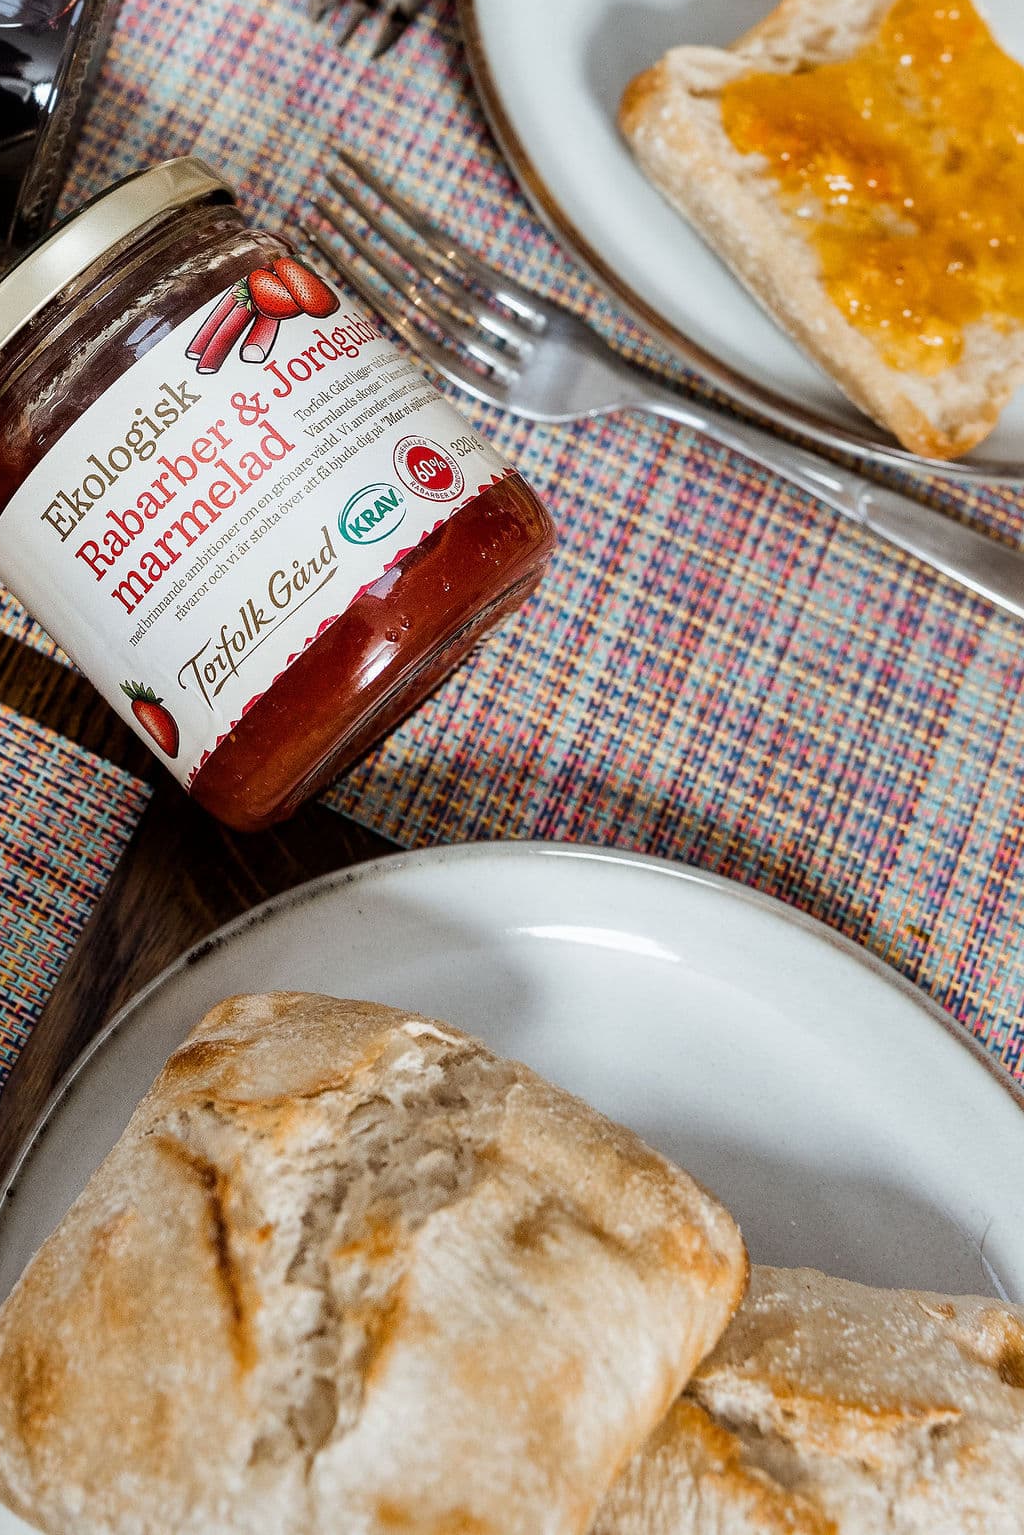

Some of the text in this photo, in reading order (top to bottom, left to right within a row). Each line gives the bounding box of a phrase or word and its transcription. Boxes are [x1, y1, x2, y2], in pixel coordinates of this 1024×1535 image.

[40, 380, 202, 543] Ekologisk
[292, 390, 335, 422] Torfolk
[328, 373, 355, 396] Gård
[347, 363, 374, 383] ligger
[302, 396, 359, 438] Värmlands
[354, 380, 385, 402] skogar.
[412, 454, 448, 483] 60%
[448, 434, 476, 459] 320
[75, 420, 233, 582] Rabarber
[229, 391, 271, 427] &
[111, 419, 296, 615] marmelad
[128, 622, 148, 648] med
[140, 579, 187, 629] brinnande
[185, 523, 240, 581] ambitioner
[239, 506, 260, 526] om
[257, 492, 275, 510] en
[270, 457, 314, 499] grönare
[310, 432, 343, 460] värld.
[335, 421, 355, 437] Vi
[350, 396, 391, 429] använder
[174, 581, 210, 622] råvaror
[207, 563, 230, 585] och
[225, 549, 241, 565] vi
[234, 539, 251, 556] är
[249, 512, 283, 545] stolta
[276, 489, 305, 515] över
[302, 475, 322, 495] att
[315, 464, 333, 481] få
[325, 444, 360, 471] bjuda
[355, 431, 376, 449] dig
[369, 421, 386, 440] på
[401, 402, 414, 416] vi
[348, 488, 399, 539] KRAV
[178, 525, 337, 711] Torfolk Gård
